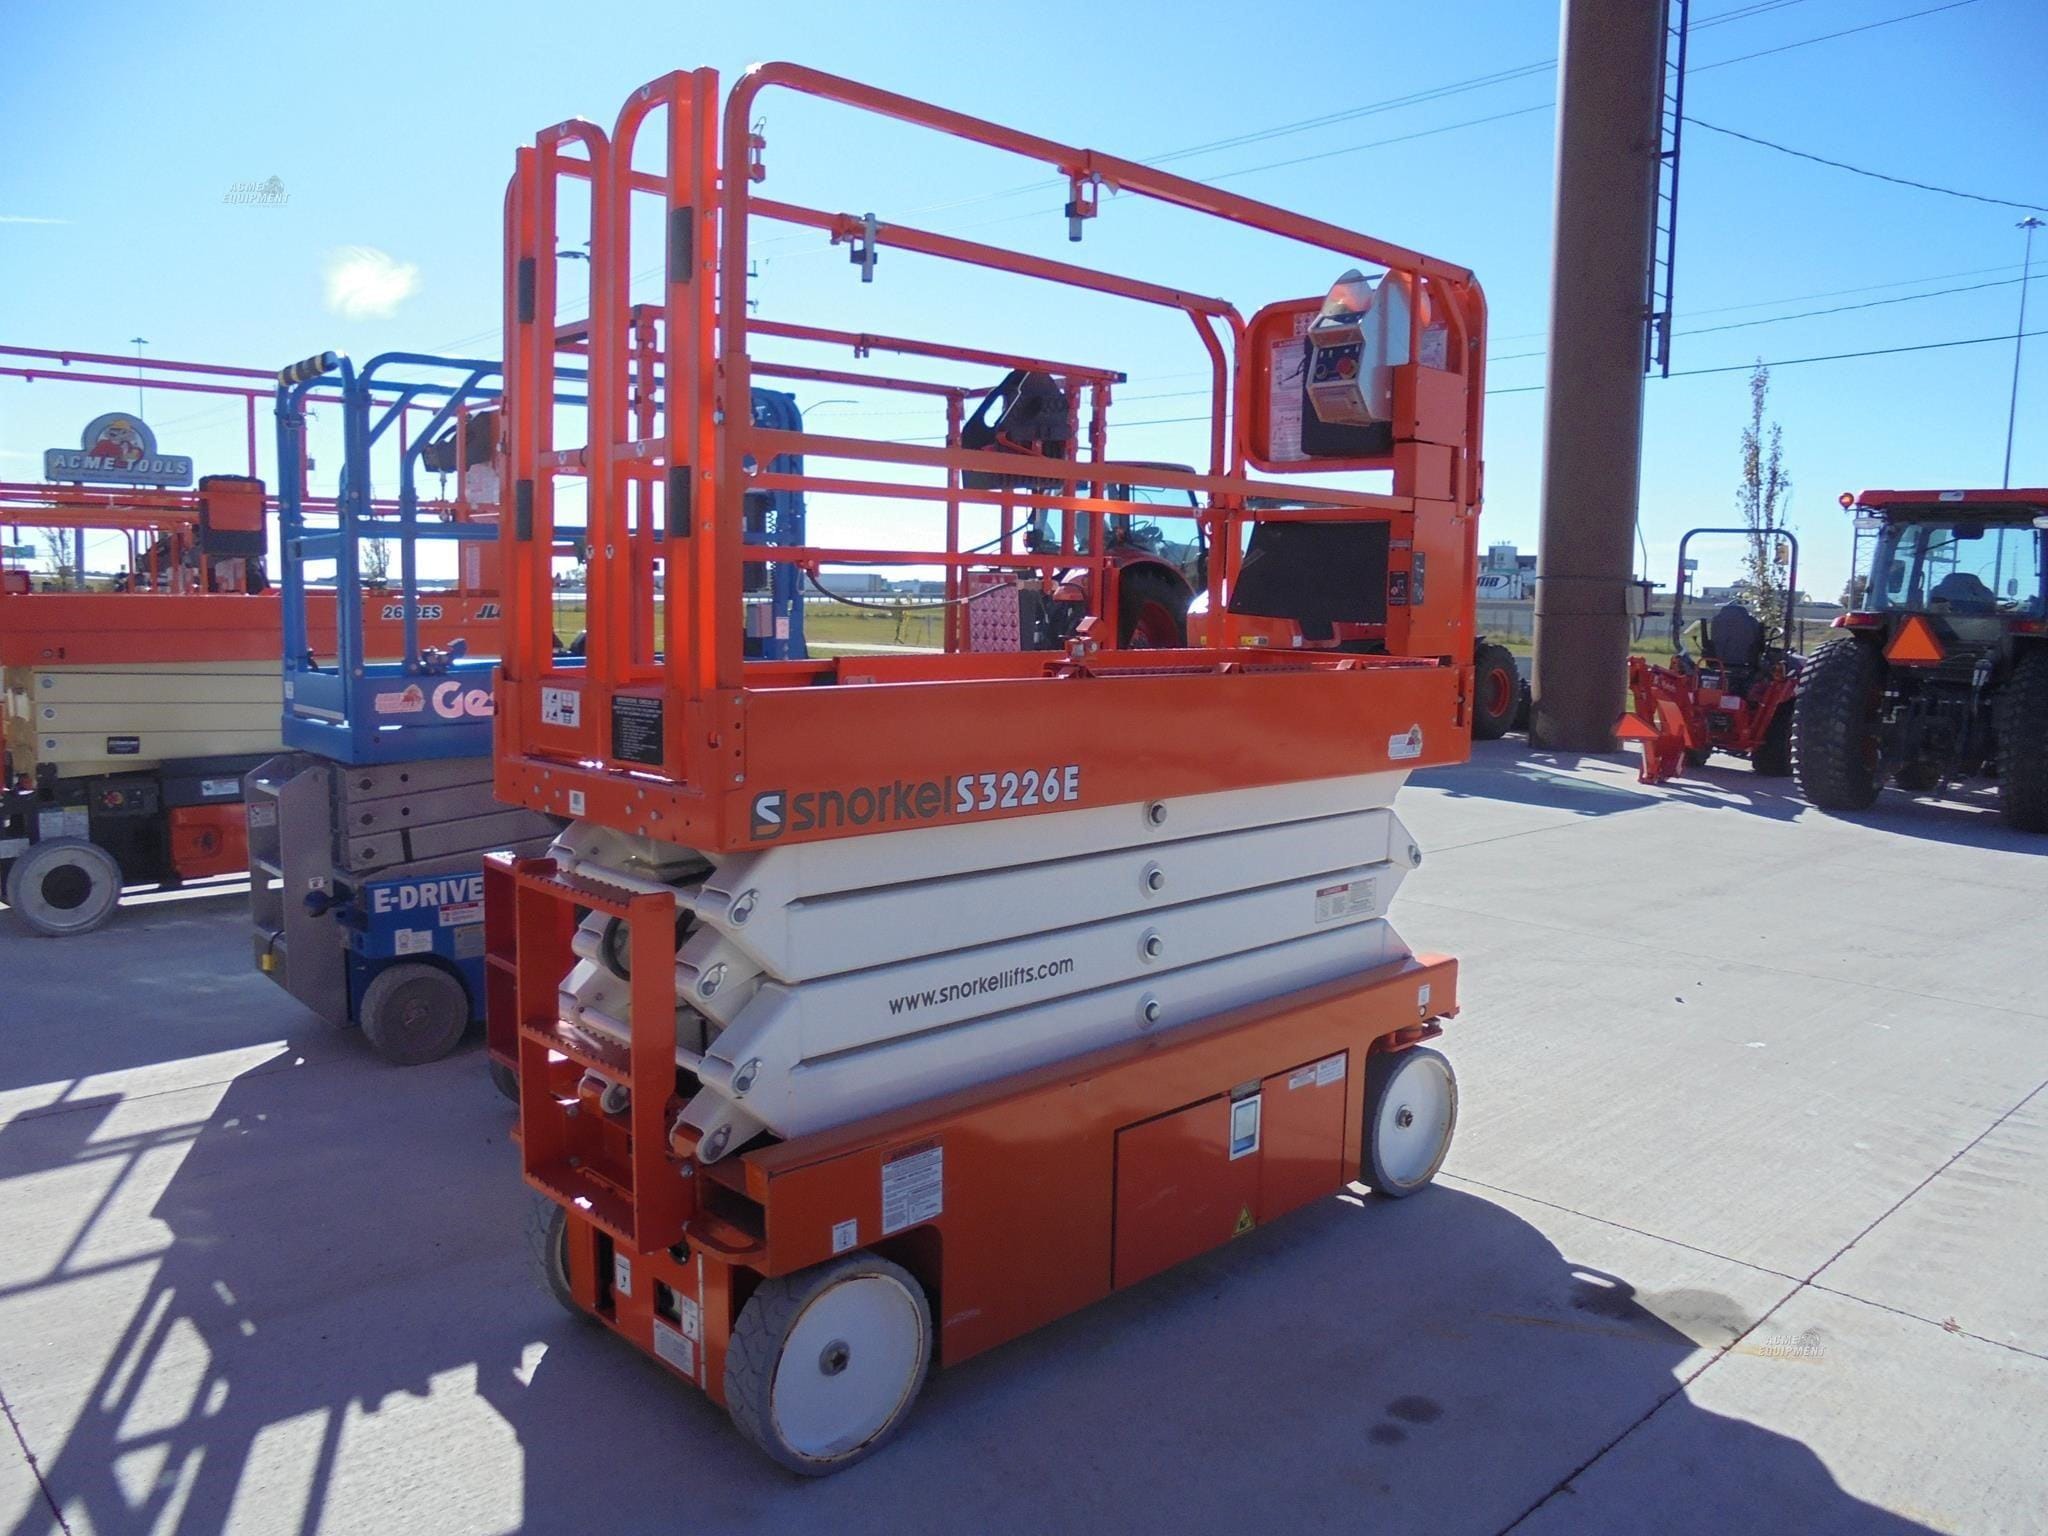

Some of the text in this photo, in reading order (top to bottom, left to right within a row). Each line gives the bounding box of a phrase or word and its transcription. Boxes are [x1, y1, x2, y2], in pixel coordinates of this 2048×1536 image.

[54, 454, 188, 475] ACME TOOLS
[382, 604, 442, 620] 262ES
[432, 681, 495, 718] Ge
[791, 775, 953, 831] snorkel
[956, 765, 1080, 814] S3226E
[374, 876, 484, 913] E-DRIVE
[888, 957, 1074, 1015] www.snorkellifts.com
